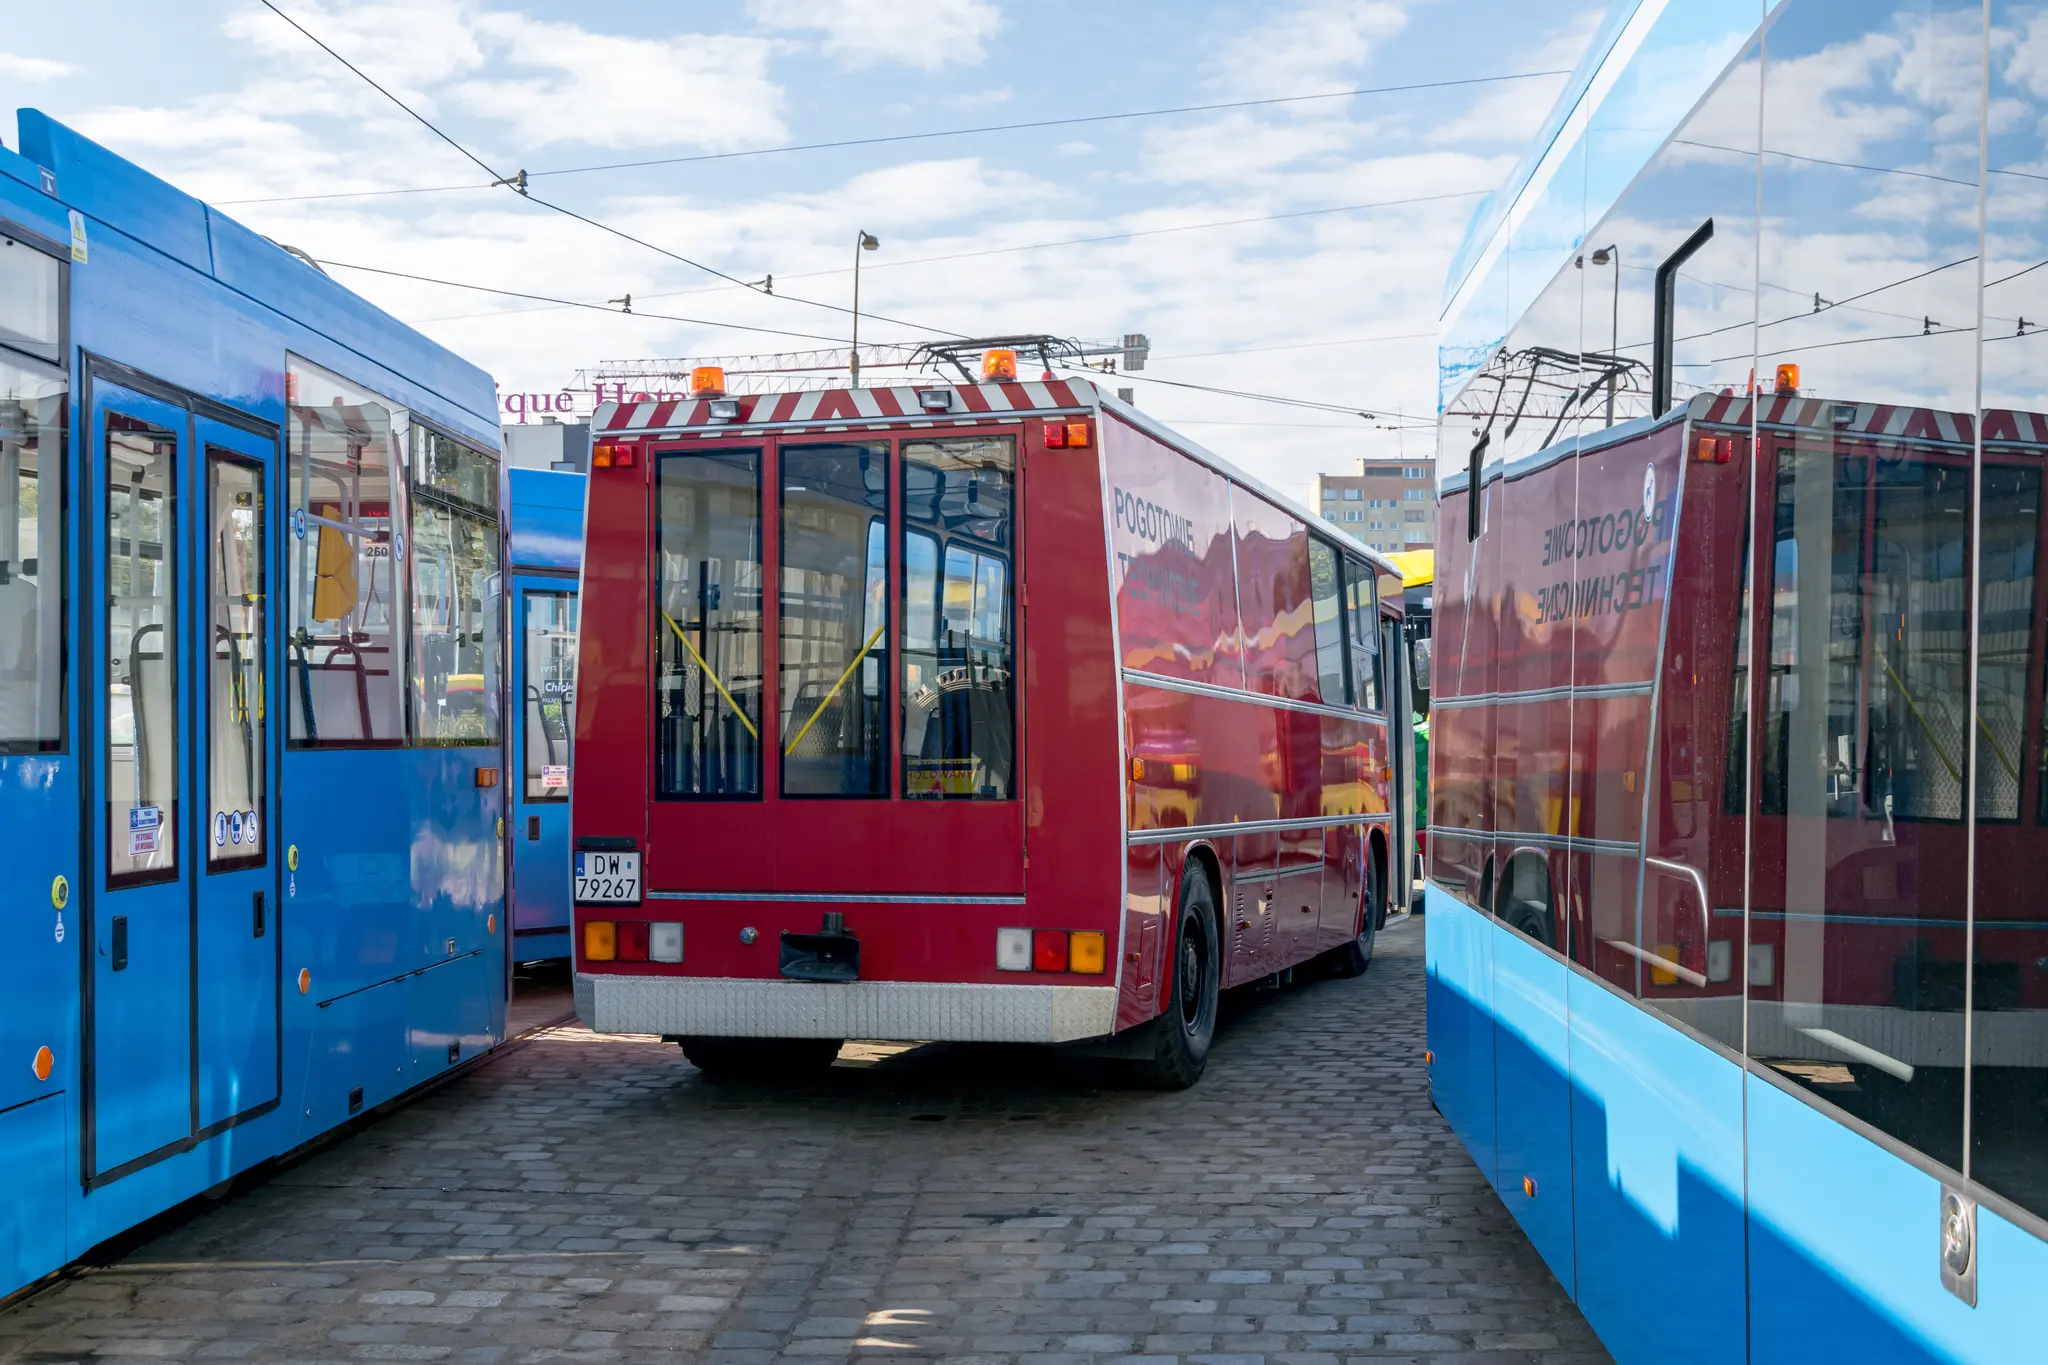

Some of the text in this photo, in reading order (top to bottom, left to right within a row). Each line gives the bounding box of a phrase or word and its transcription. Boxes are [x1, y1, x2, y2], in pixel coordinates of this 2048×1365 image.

[495, 382, 574, 424] que
[1114, 486, 1196, 558] POGOTOWIE
[367, 546, 388, 557] 260
[1117, 551, 1201, 617] TECHNICZNE
[594, 855, 620, 875] DW
[578, 878, 636, 899] 79267
